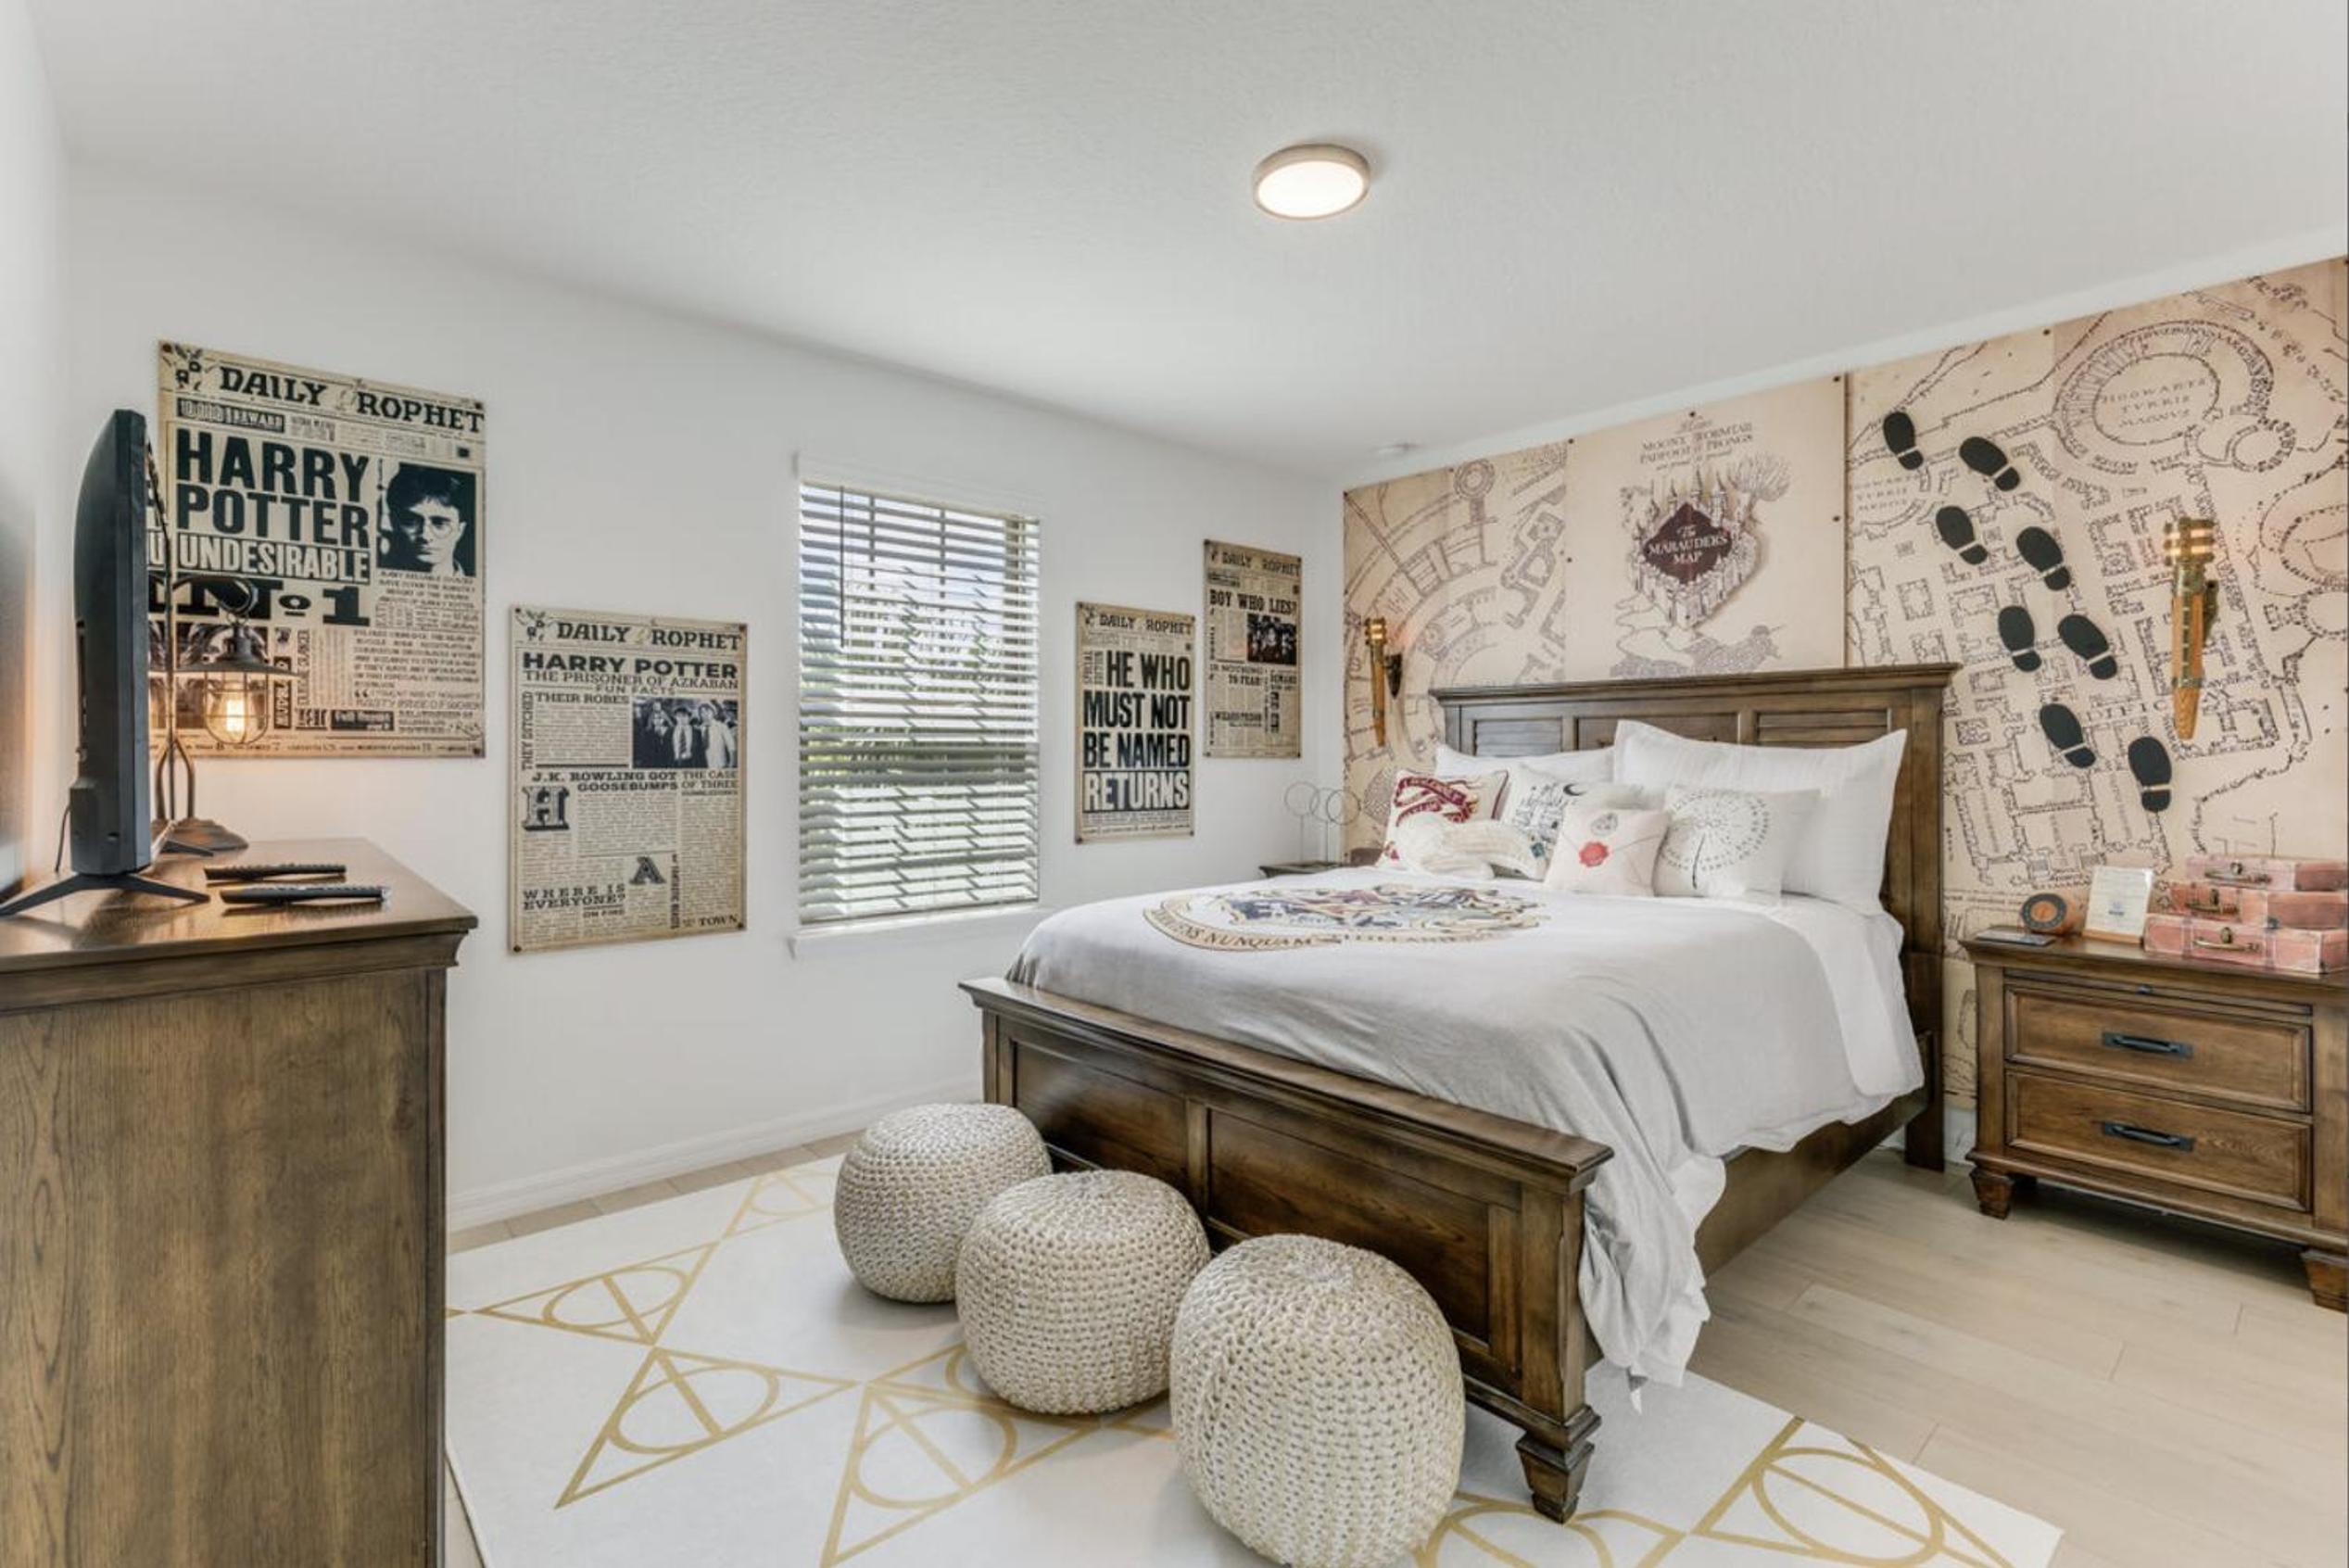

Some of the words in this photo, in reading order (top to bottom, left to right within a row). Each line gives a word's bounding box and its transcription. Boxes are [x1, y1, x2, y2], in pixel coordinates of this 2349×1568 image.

[220, 366, 327, 407] DAILY
[176, 428, 370, 502] HARRY
[176, 483, 370, 549] POTTER
[179, 535, 370, 584] UNDESIRABLE
[1209, 588, 1232, 607] BOY
[1237, 593, 1265, 613] WHO
[1099, 613, 1136, 630] DAILY
[556, 621, 631, 643] DAILY
[638, 626, 742, 651] ROPHET
[523, 652, 626, 674] HARRY
[635, 658, 739, 679] POTTER
[1106, 650, 1134, 688] HE
[1140, 651, 1191, 690] WHO
[523, 671, 558, 683] THE
[562, 671, 643, 687] PRISONER
[646, 675, 665, 687] OF
[669, 676, 739, 690] AZKABAN
[596, 684, 625, 694] FUN
[631, 685, 676, 696] FACTS
[537, 692, 582, 704] THEIR
[583, 693, 630, 705] ROBES
[1083, 689, 1145, 728] MUST
[1151, 693, 1191, 730] NOT
[1083, 731, 1112, 768] BE
[1117, 732, 1191, 768] NAMED
[531, 772, 566, 782] J.K.
[570, 771, 645, 782] ROWLING
[649, 771, 678, 781] GOT
[576, 781, 679, 792] GOOSEBUMPS
[1084, 771, 1190, 810] RETURNS
[524, 885, 598, 900] WHERE
